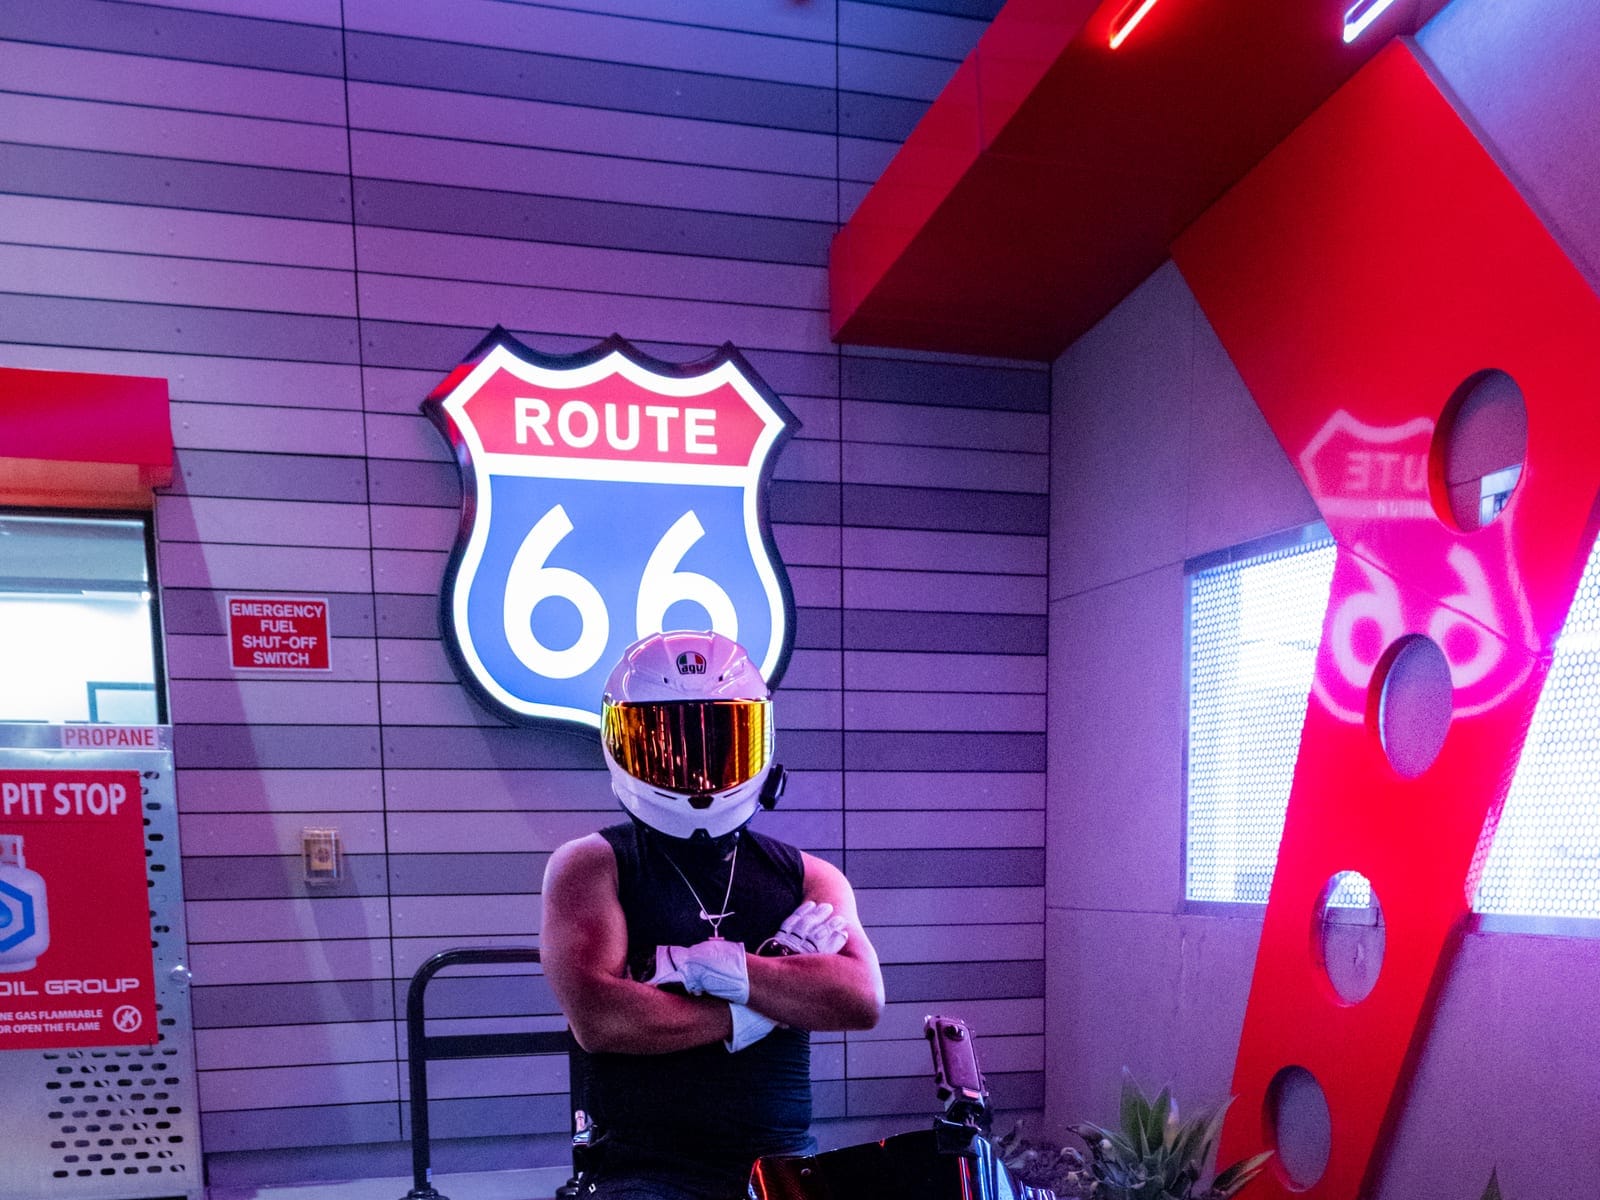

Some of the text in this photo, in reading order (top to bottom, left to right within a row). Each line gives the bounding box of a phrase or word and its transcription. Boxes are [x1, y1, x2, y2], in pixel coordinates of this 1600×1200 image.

[514, 397, 718, 455] ROUTE
[503, 503, 738, 679] 66
[231, 603, 323, 618] EMERGENCY
[261, 619, 298, 633] FUEL
[242, 635, 318, 649] SHUT-OFF
[253, 651, 309, 665] SWITCH
[64, 728, 155, 746] PROPANE
[2, 783, 126, 815] PIT STOP
[45, 978, 140, 995] GROUP
[15, 1011, 37, 1021] GAS
[38, 1009, 103, 1020] FLAMMABLE
[13, 1024, 42, 1033] OPEN
[43, 1023, 64, 1032] THE
[65, 1022, 101, 1031] FLAME
